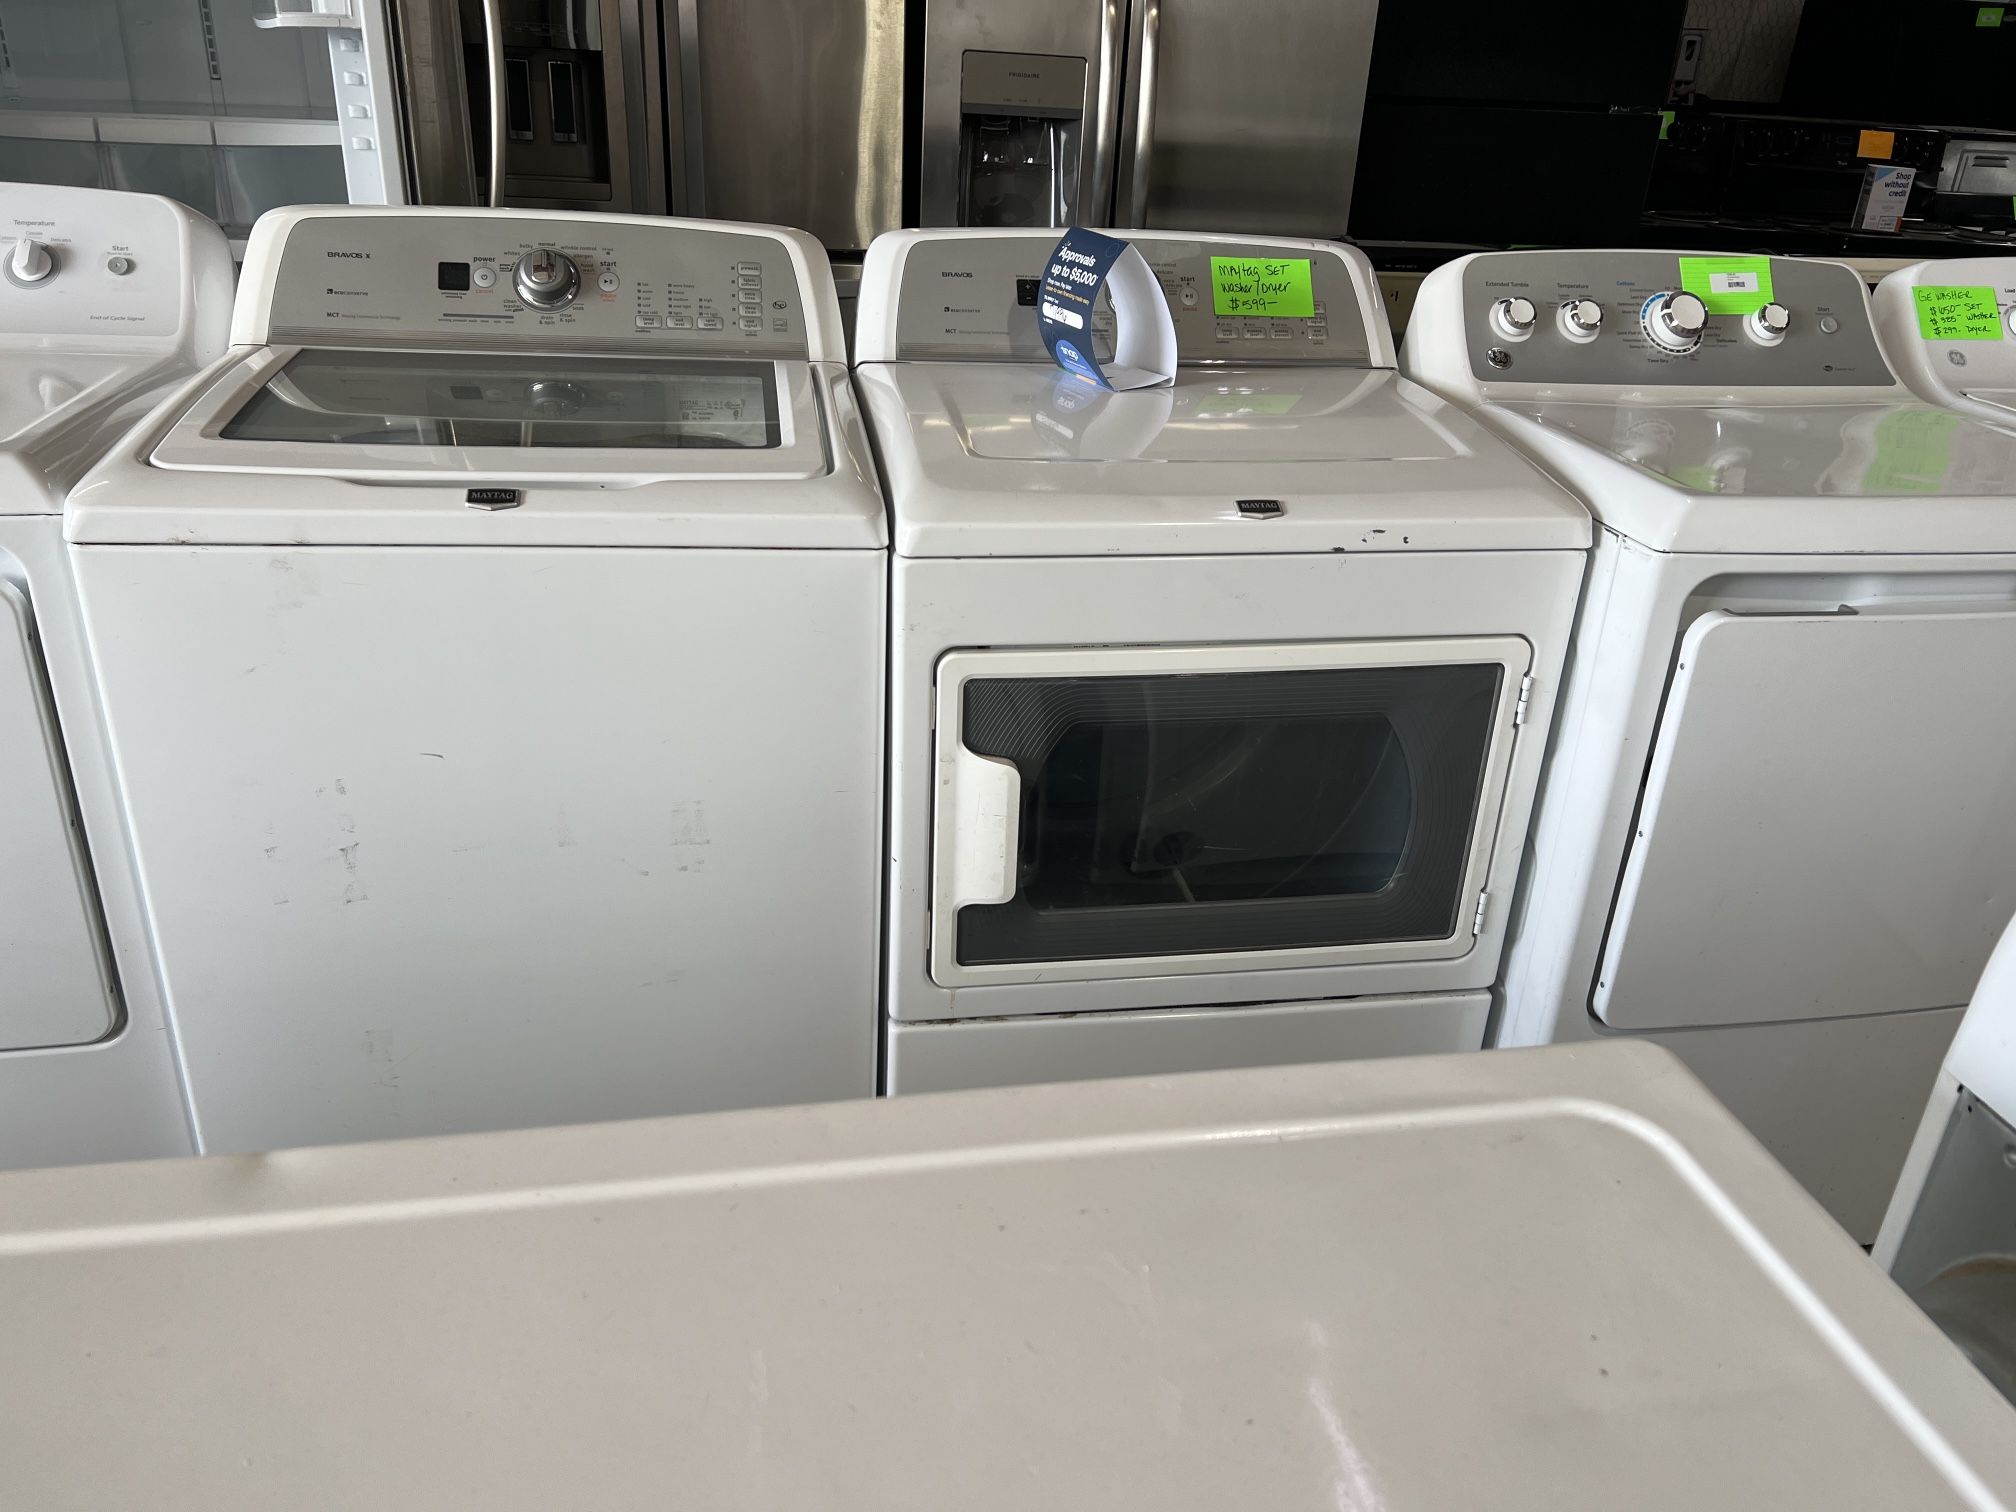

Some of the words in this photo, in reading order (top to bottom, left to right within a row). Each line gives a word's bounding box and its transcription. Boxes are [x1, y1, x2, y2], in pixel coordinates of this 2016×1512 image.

[1008, 71, 1040, 79] FRIGIDAIRE
[1896, 172, 1912, 181] Shop
[1884, 181, 1909, 189] without
[14, 219, 56, 227] Temperature
[327, 251, 363, 259] BRAVOS
[1058, 247, 1096, 267] Approvals
[1051, 263, 1061, 277] up
[1061, 265, 1070, 278] to
[1265, 264, 1290, 276] SET
[942, 271, 973, 279] BRAVOS
[1557, 282, 1589, 290] Temperature
[1918, 290, 1933, 302] GE
[1935, 290, 1973, 301] WASHER
[1963, 303, 1984, 311] SET
[326, 311, 339, 319] MCT
[1966, 312, 1997, 321] WASHER
[471, 491, 514, 499] MAYTAG
